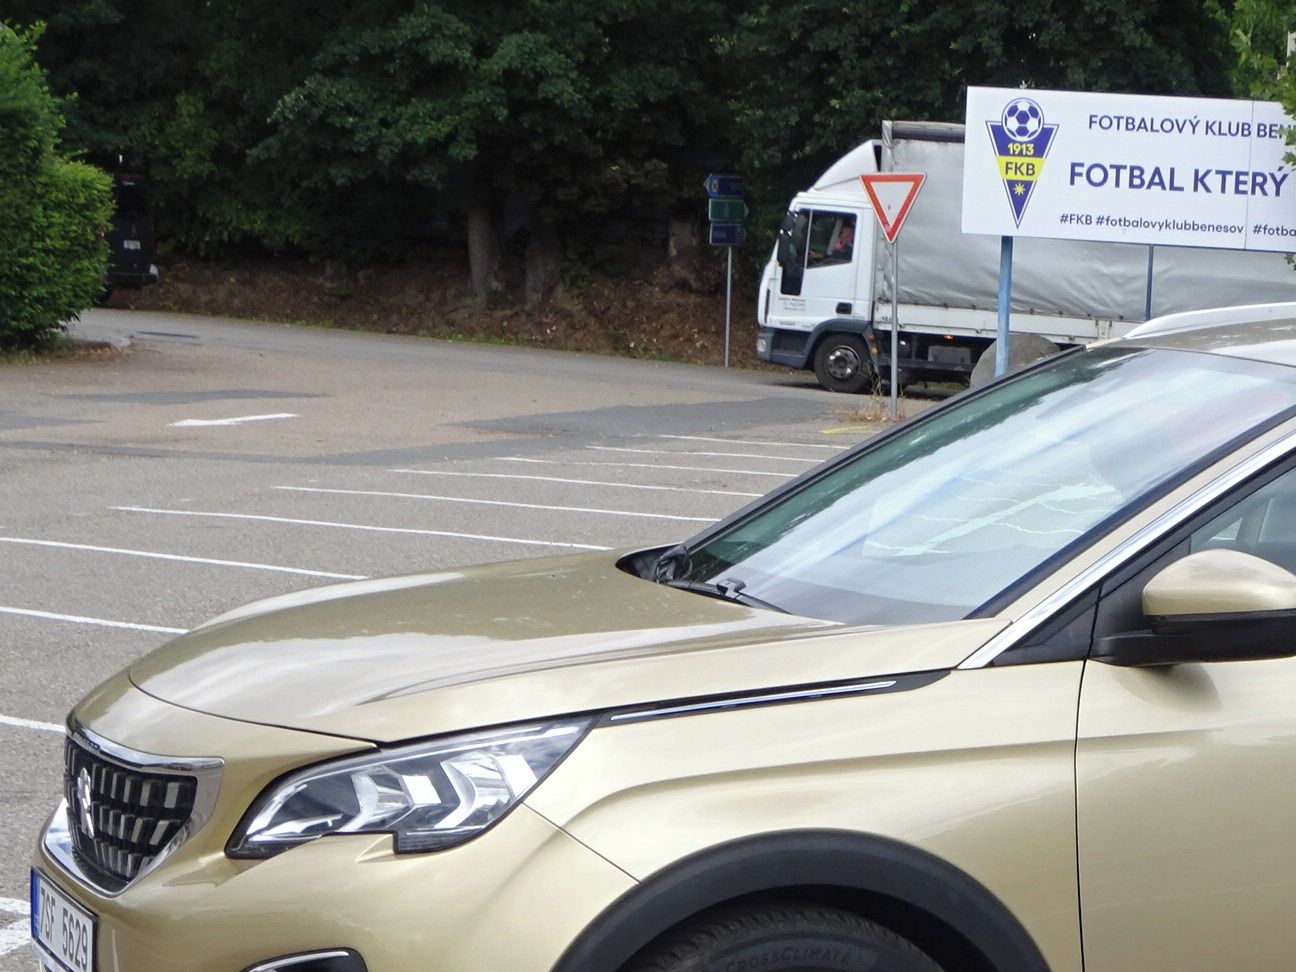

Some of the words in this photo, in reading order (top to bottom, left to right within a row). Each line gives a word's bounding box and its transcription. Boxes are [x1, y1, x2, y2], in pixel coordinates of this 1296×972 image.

[1089, 114, 1201, 136] FOTBALOVÝ
[1204, 119, 1252, 138] KLUB
[1007, 142, 1035, 156] 1913
[1004, 161, 1036, 177] FKB
[1069, 161, 1185, 192] FOTBAL
[1192, 165, 1289, 198] KTERÝ
[1059, 213, 1093, 226] #FKB
[1095, 214, 1244, 234] #fotbalovyklubbenesov
[62, 907, 88, 972] 5629
